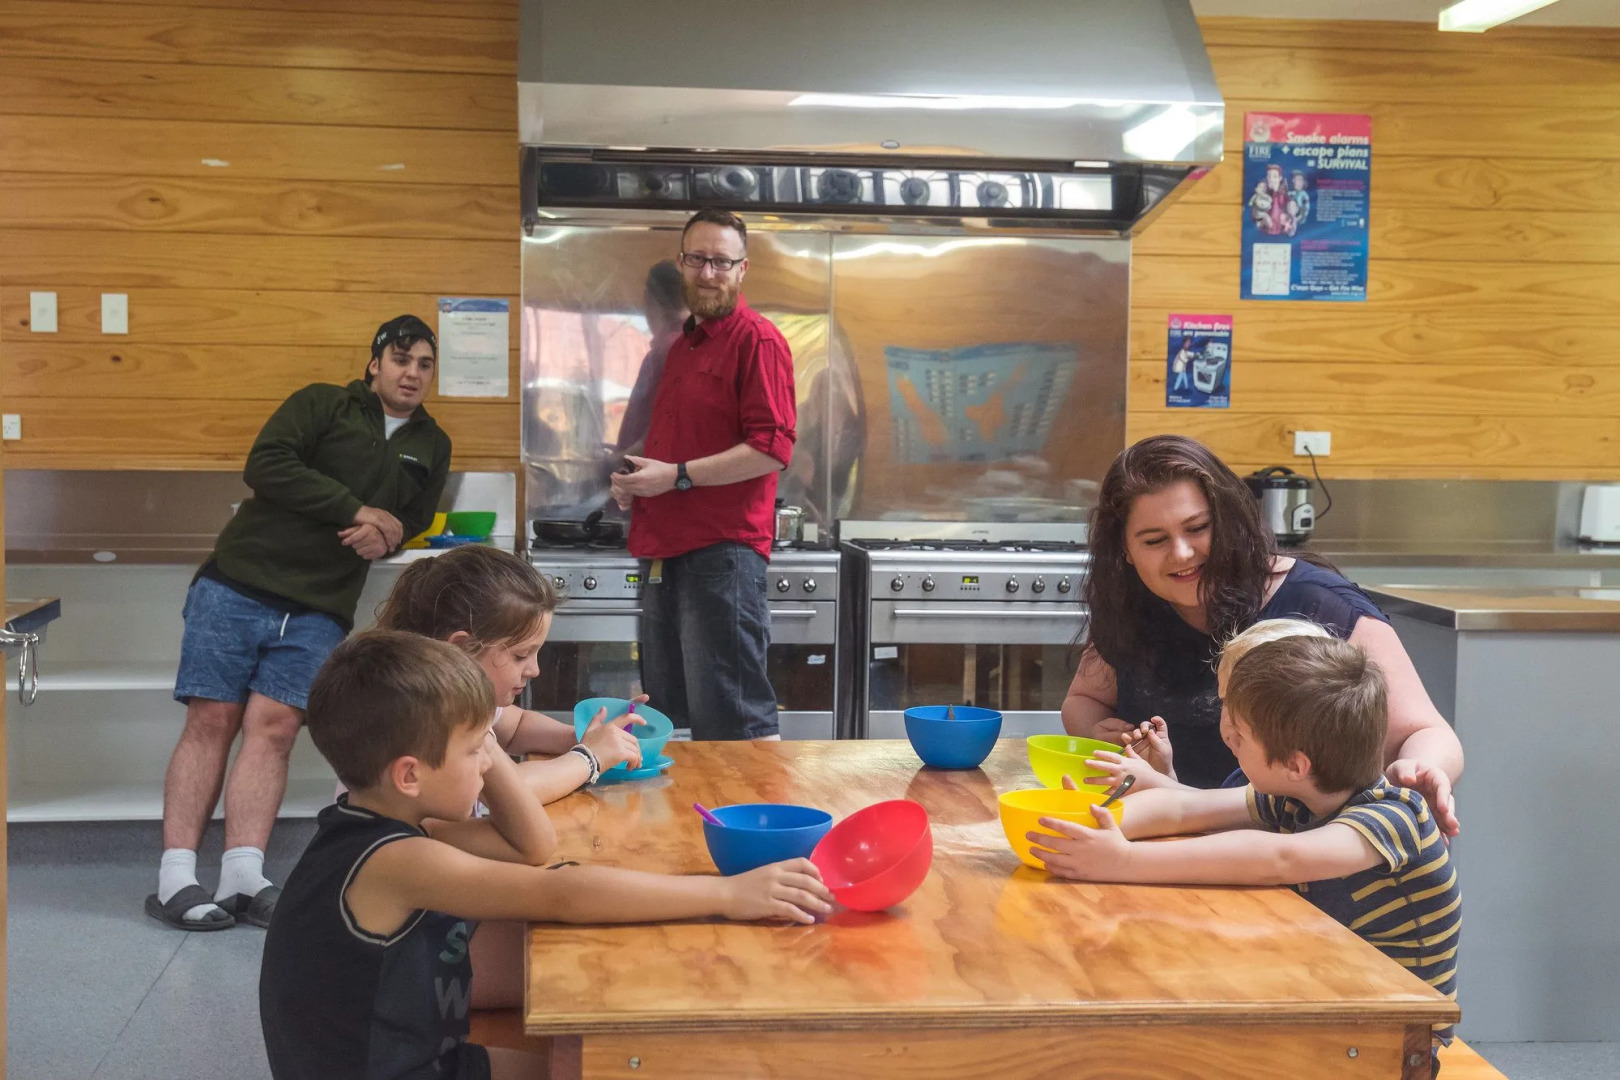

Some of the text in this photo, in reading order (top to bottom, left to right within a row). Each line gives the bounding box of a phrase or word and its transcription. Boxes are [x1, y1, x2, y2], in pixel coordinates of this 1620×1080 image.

[1286, 131, 1369, 145] Smoke alarms
[1293, 147, 1334, 158] escape
[1337, 145, 1369, 158] plans
[1317, 158, 1368, 170] SURVIVAL
[1183, 321, 1212, 330] Kitchen
